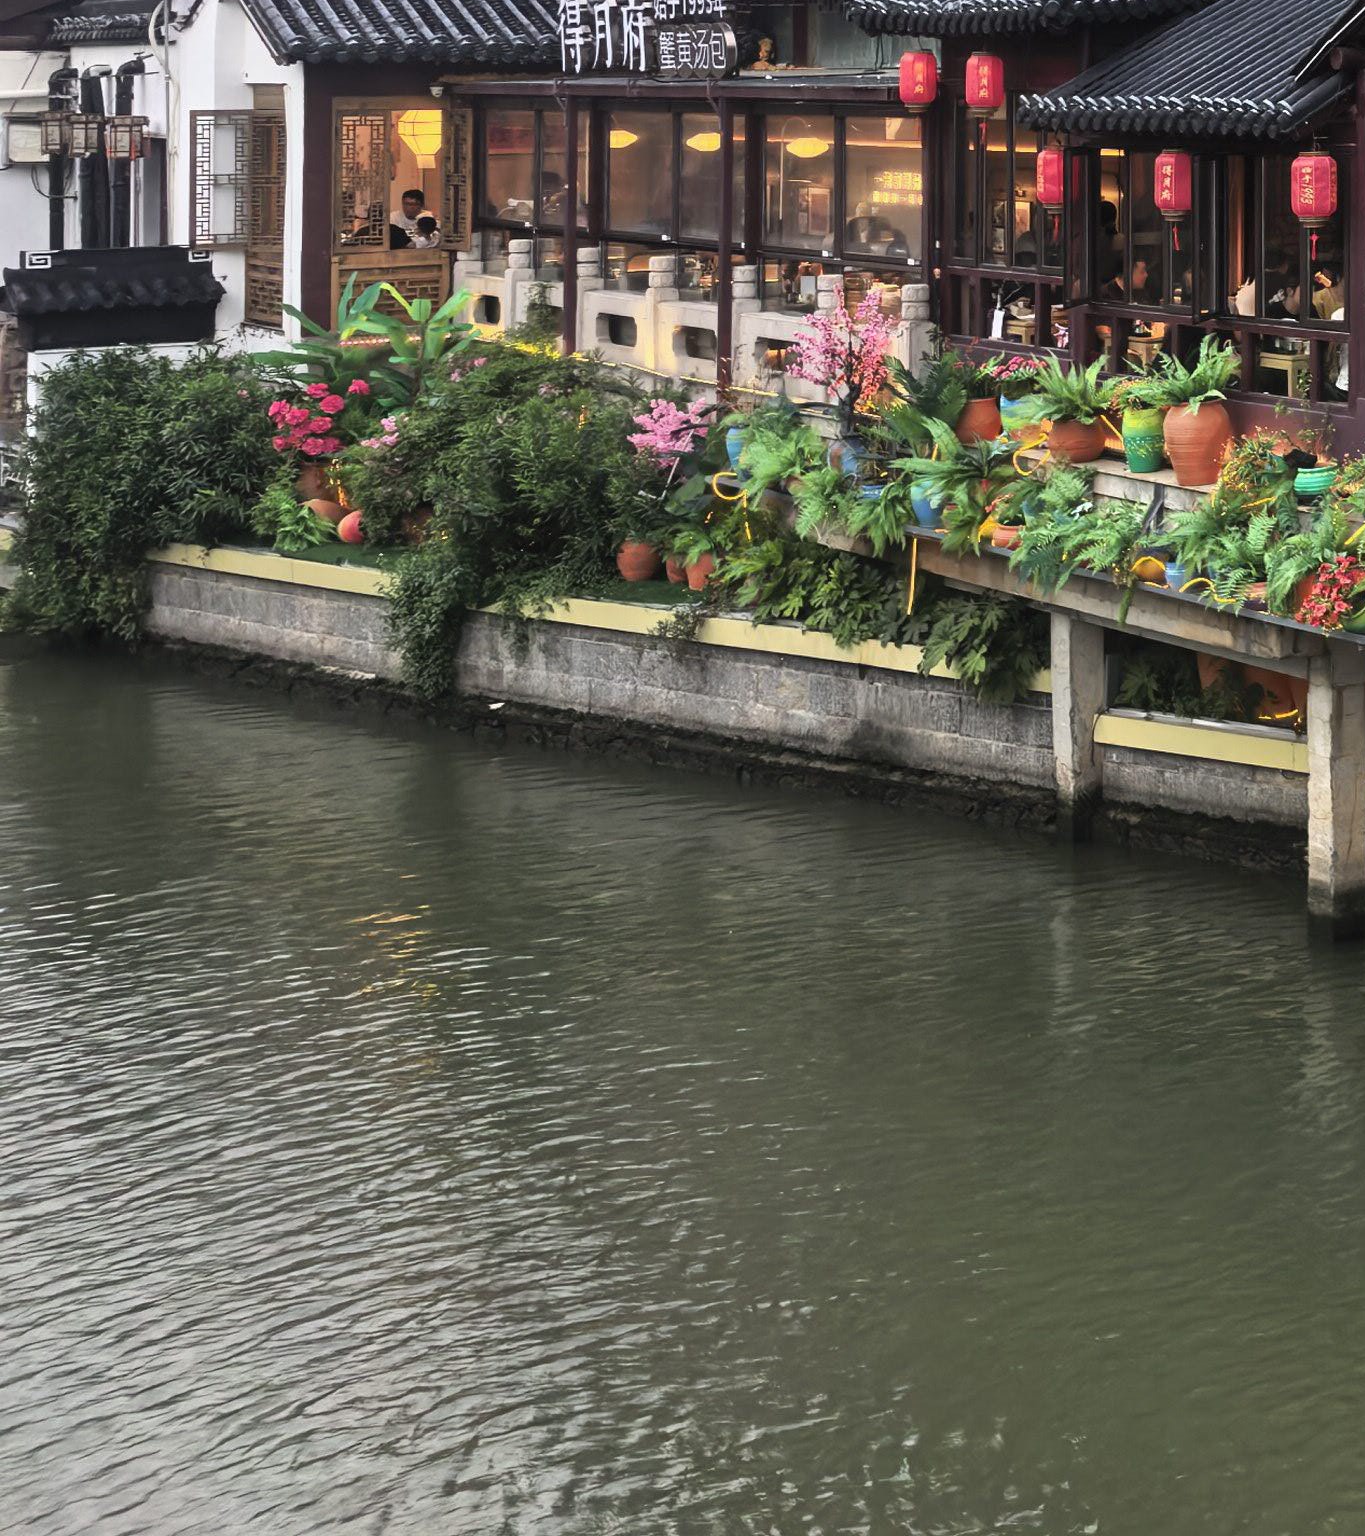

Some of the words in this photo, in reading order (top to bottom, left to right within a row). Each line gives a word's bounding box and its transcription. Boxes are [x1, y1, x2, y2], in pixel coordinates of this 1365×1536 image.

[659, 29, 726, 70] 蟹黄汤包
[1161, 163, 1175, 202] 得月府
